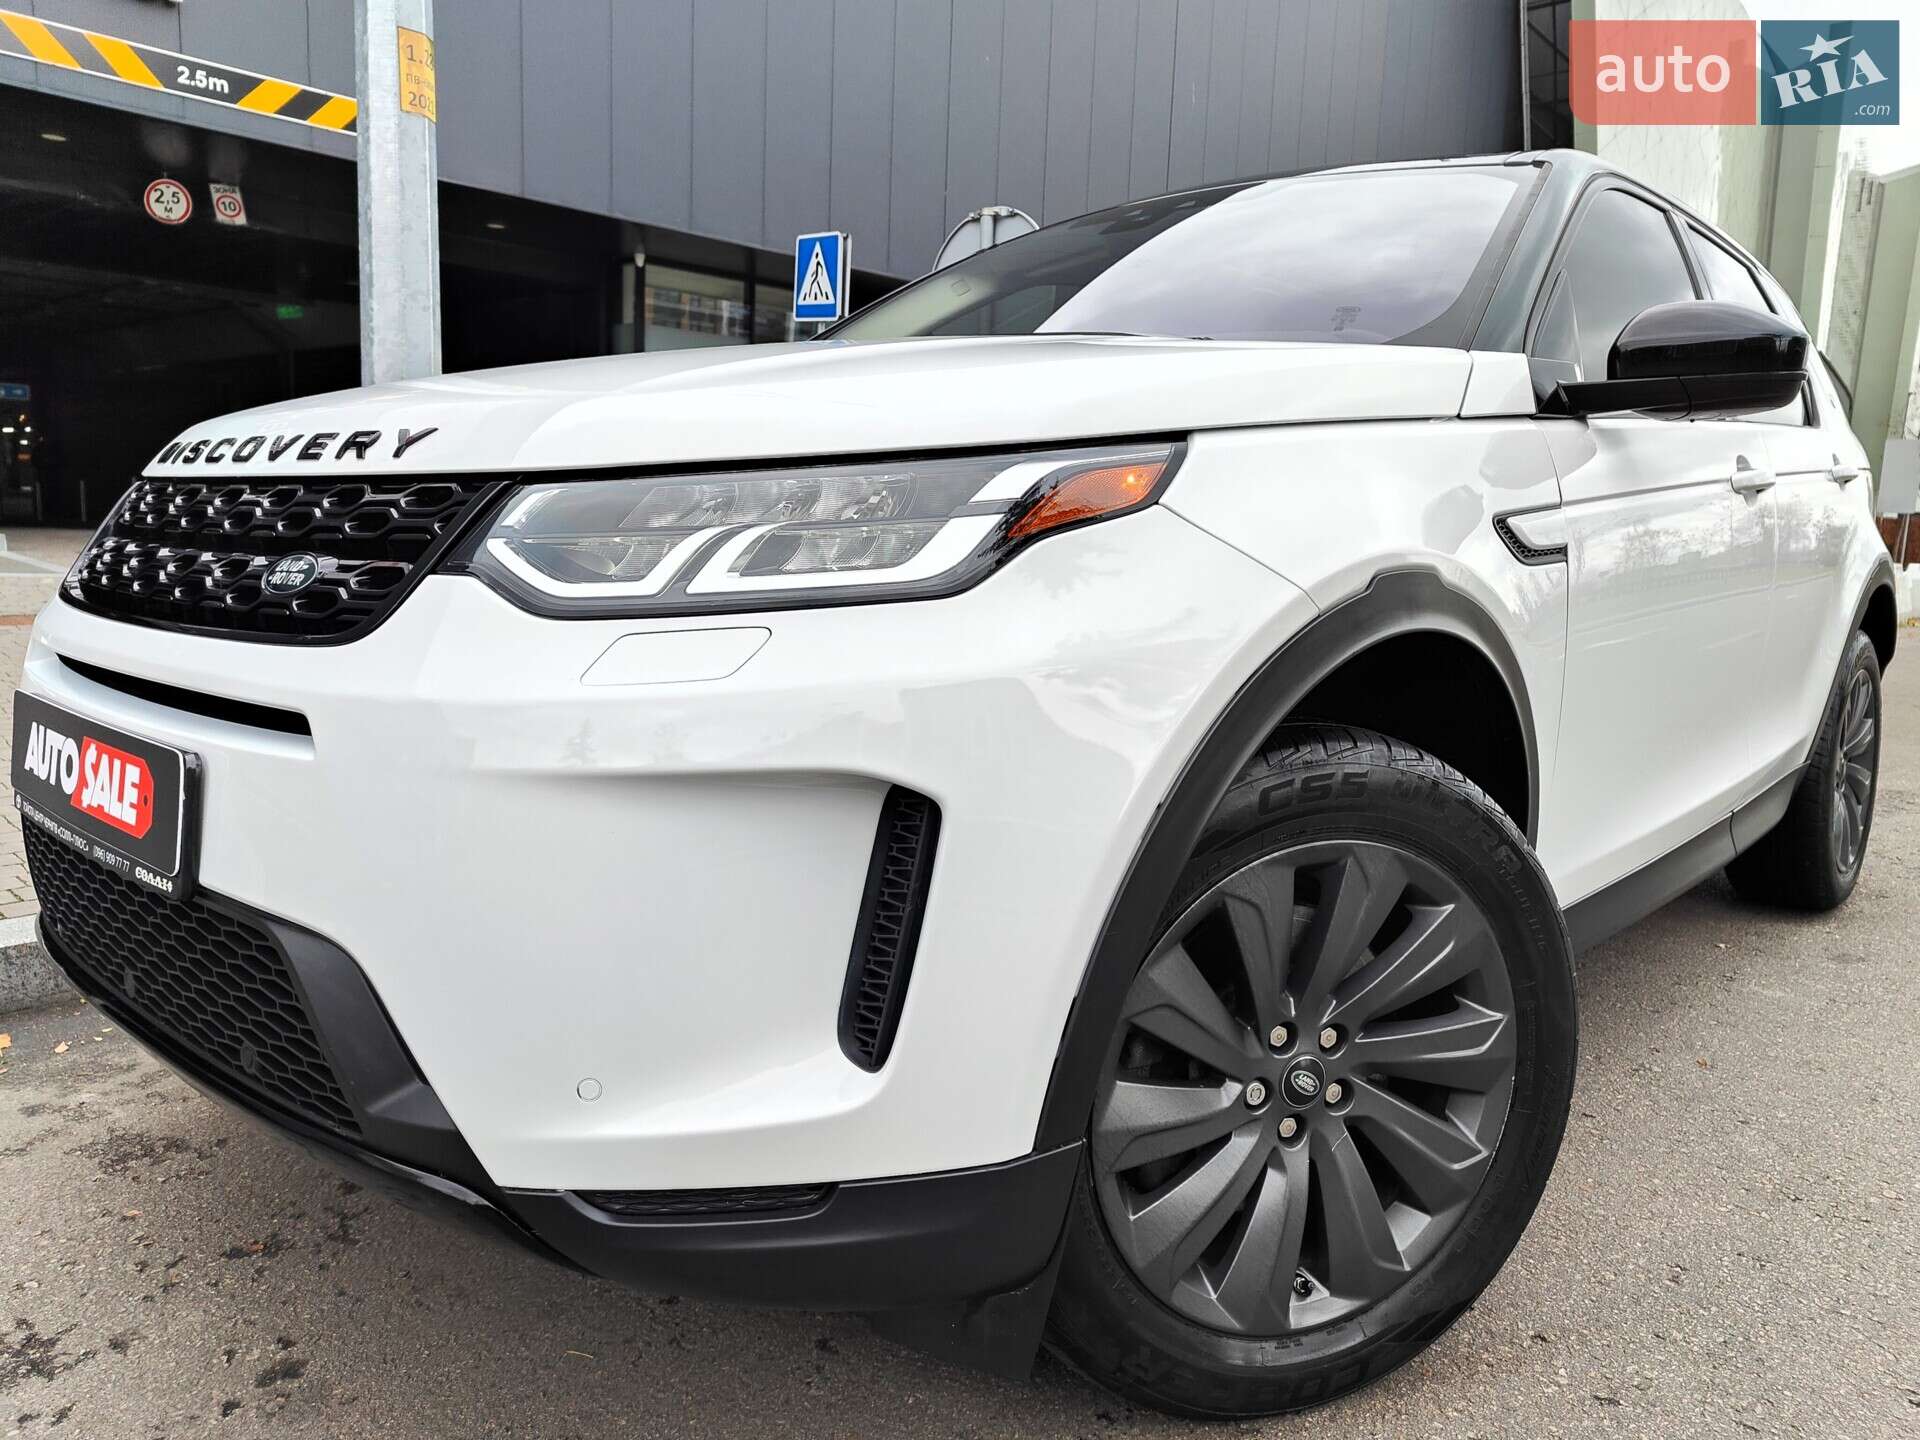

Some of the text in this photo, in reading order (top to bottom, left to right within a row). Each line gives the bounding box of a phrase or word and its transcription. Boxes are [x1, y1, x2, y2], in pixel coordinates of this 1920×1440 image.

[176, 65, 229, 94] 2.5m
[154, 188, 180, 205] 2,5
[221, 201, 237, 212] 10
[157, 427, 439, 464] DISCOVERY
